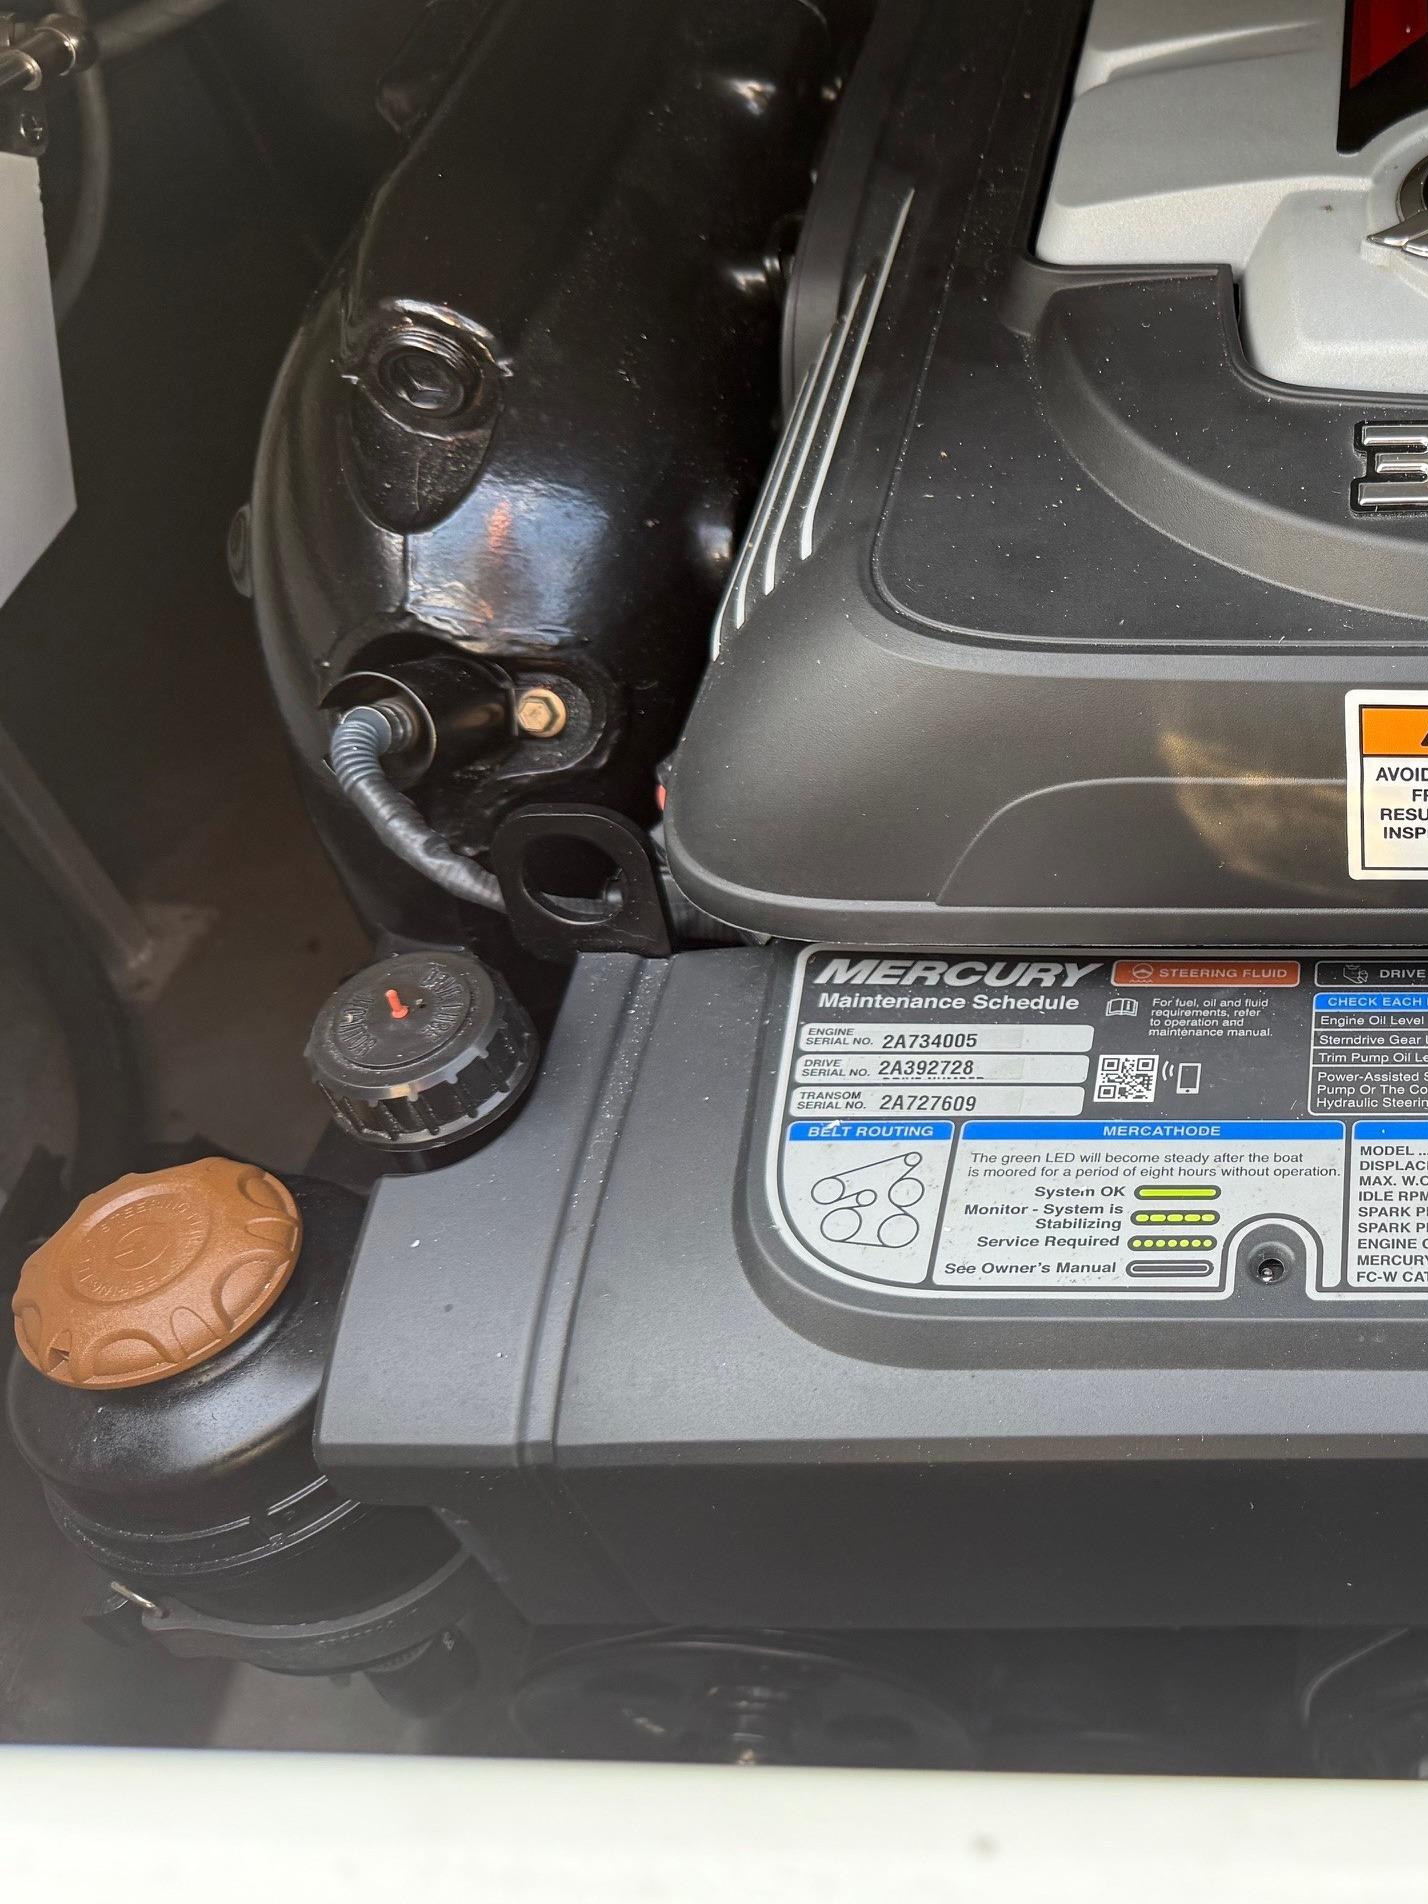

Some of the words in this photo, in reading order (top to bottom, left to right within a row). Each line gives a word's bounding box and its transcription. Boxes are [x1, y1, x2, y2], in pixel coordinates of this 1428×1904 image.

[814, 958, 1104, 988] MERCURY
[1159, 969, 1237, 978] STEERING
[1242, 969, 1287, 978] FLUID
[1380, 969, 1425, 978] DRIVE
[818, 992, 966, 1010] Maintenance
[973, 992, 1080, 1010] Schedule
[1328, 997, 1377, 1006] CHECK
[1383, 997, 1421, 1006] EACH
[1321, 1016, 1364, 1027] Engine
[1369, 1016, 1386, 1027] Oil
[1391, 1016, 1424, 1027] Level
[808, 1027, 854, 1036] ENGINE
[806, 1037, 849, 1046] SERIAL
[853, 1037, 873, 1046] NO.
[882, 1034, 977, 1049] 2A734005
[1319, 1035, 1384, 1044] Sterndrive
[1389, 1035, 1421, 1044] Gear
[804, 1059, 841, 1067] DRIVE
[1319, 1053, 1346, 1064] Trim
[1351, 1053, 1389, 1064] Pump
[1393, 1053, 1410, 1064] Oil
[802, 1069, 845, 1077] SERIAL
[849, 1069, 870, 1077] NO.
[878, 1060, 973, 1075] 2A392728
[1318, 1072, 1419, 1083] Power-Assisted
[800, 1091, 861, 1100] TRANSOM
[1317, 1085, 1355, 1096] Pump
[1360, 1085, 1375, 1096] Or
[1381, 1085, 1404, 1096] The
[797, 1101, 841, 1110] SERIAL
[845, 1101, 866, 1110] NO.
[880, 1095, 976, 1112] 2A727609
[1316, 1098, 1378, 1109] Hydraulic
[808, 1126, 851, 1137] BELT
[856, 1126, 934, 1137] ROUTING
[1103, 1126, 1220, 1136] MERCATHODE
[971, 1152, 997, 1164] The
[1002, 1152, 1040, 1164] green
[1045, 1152, 1075, 1164] LED
[1080, 1152, 1101, 1164] will
[1105, 1152, 1160, 1164] become
[1164, 1152, 1209, 1164] steady
[1214, 1152, 1244, 1164] after
[1249, 1152, 1269, 1164] the
[1274, 1152, 1303, 1164] boat
[1034, 1186, 1095, 1199] System
[1100, 1186, 1126, 1199] OK
[1358, 1207, 1411, 1217] SPARK
[1036, 1218, 1122, 1231] Stabilizing
[977, 1236, 1040, 1249] Service
[1045, 1236, 1120, 1249] Required
[944, 1262, 976, 1275] See
[981, 1262, 1051, 1275] Owner's
[1057, 1262, 1116, 1275] Manual
[1356, 1271, 1397, 1284] FC-W
